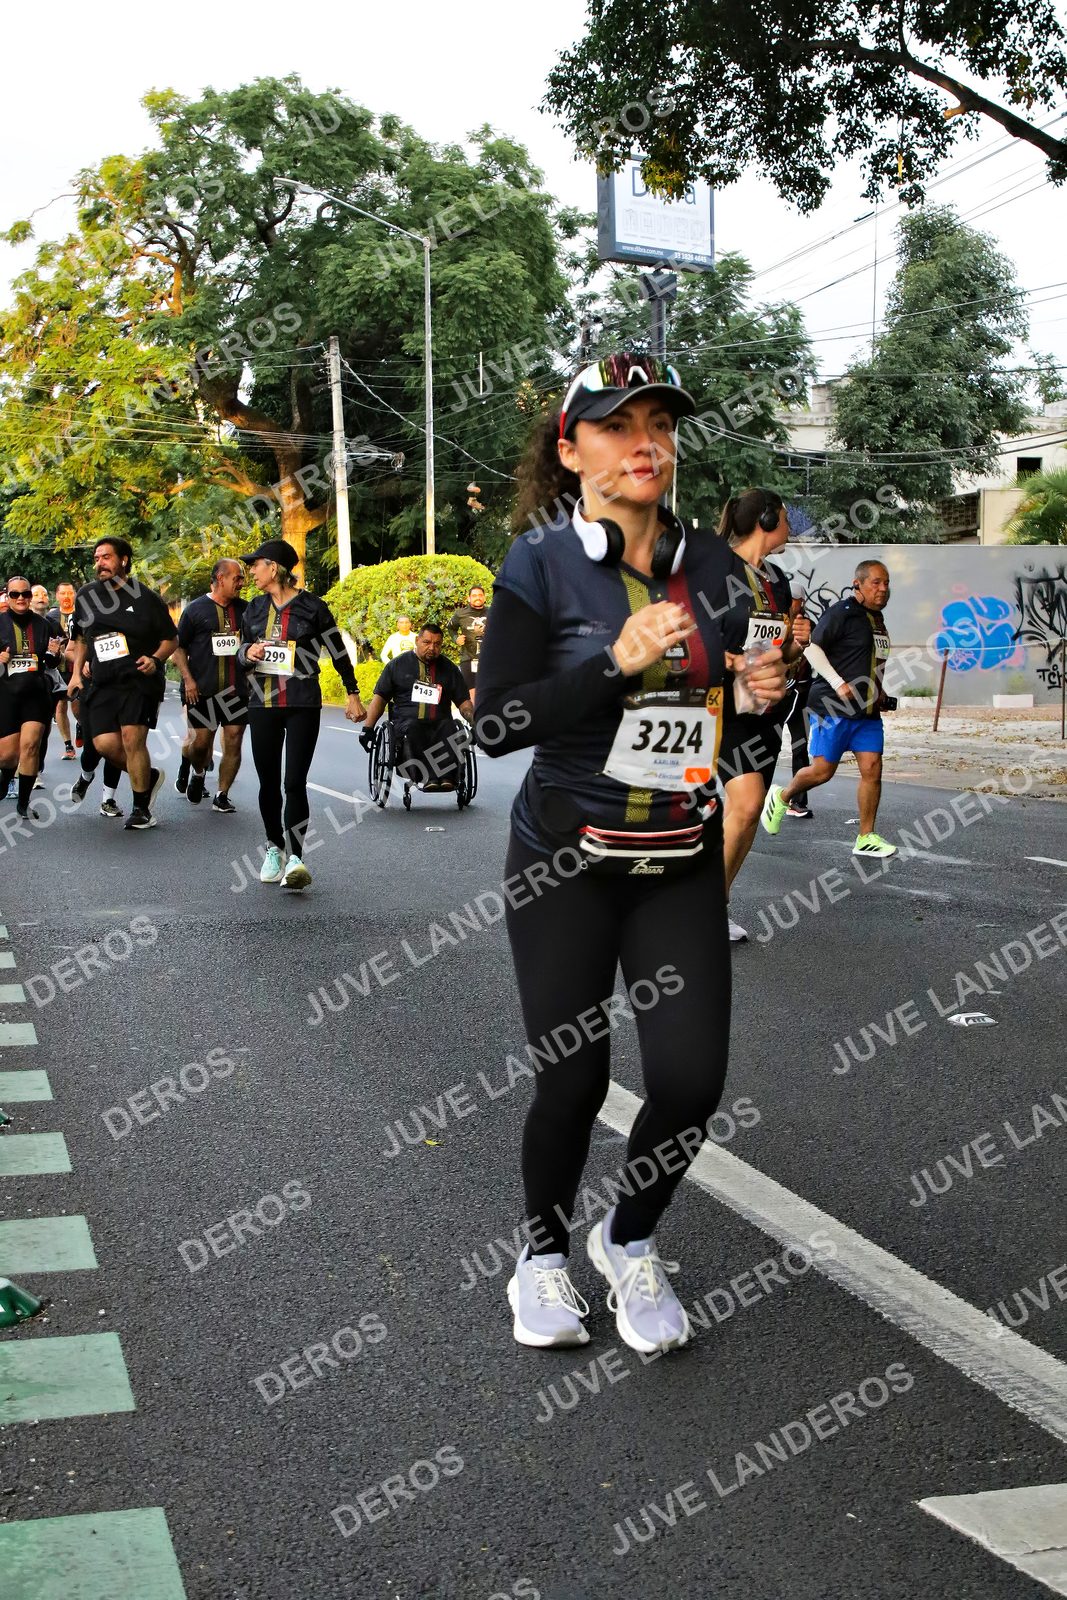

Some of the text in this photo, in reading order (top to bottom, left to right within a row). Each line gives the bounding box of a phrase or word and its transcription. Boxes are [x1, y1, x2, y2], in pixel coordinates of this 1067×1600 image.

[753, 624, 782, 640] 7089
[99, 640, 120, 652] 3256
[216, 639, 236, 647] 6949
[419, 688, 433, 696] 143
[631, 719, 703, 754] 3224
